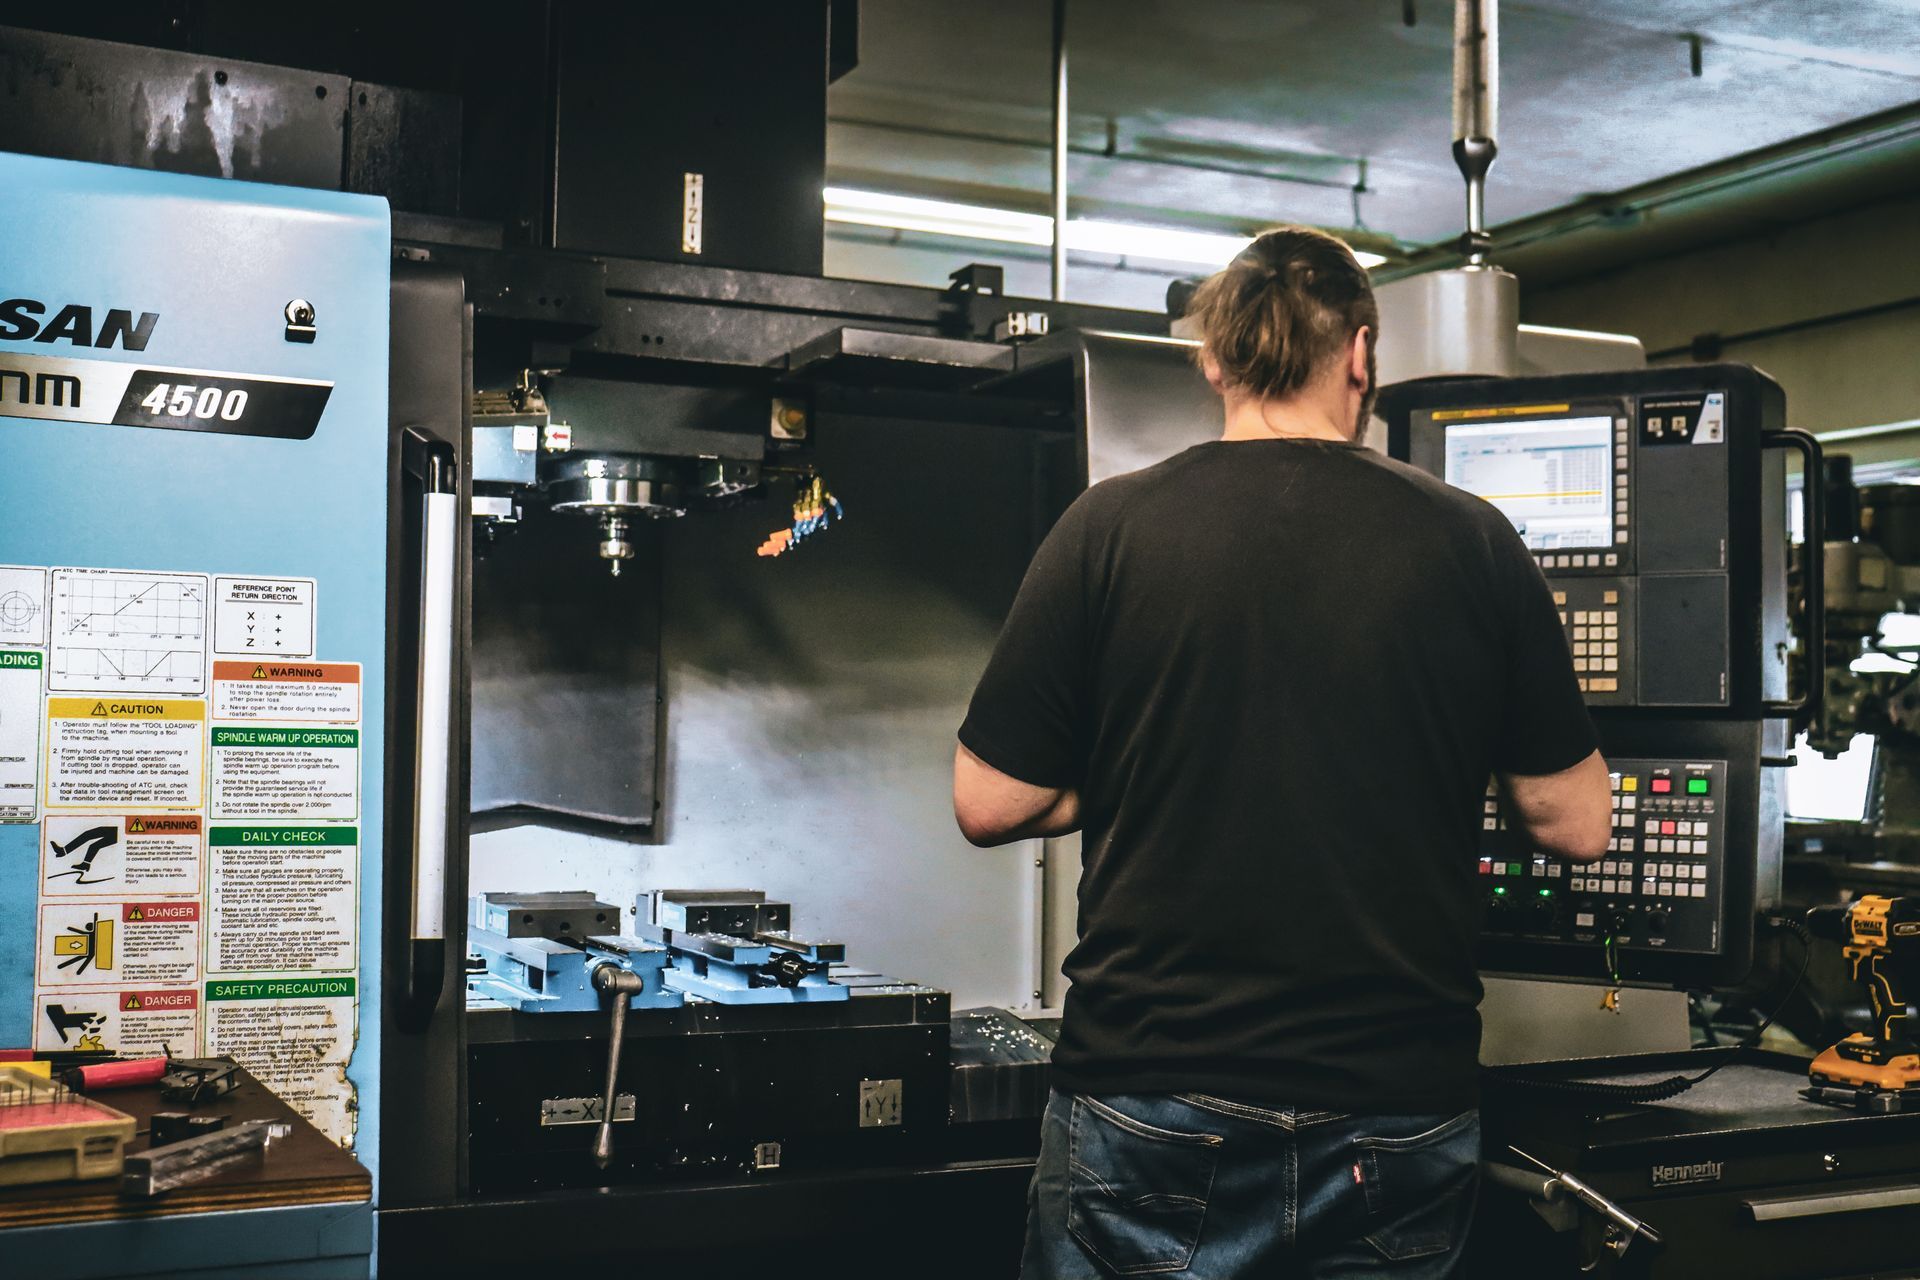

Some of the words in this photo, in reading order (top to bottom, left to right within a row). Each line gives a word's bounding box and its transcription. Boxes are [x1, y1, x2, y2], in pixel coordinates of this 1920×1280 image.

[0, 299, 160, 352] SAN
[141, 383, 248, 421] 4500
[270, 668, 323, 678] WARNING
[111, 705, 163, 714] CAUTION
[218, 733, 255, 742] SPINDLE
[258, 733, 286, 743] WARM
[288, 734, 300, 743] UP
[303, 734, 354, 744] OPERATION
[145, 820, 197, 829] WARNING
[243, 832, 279, 841] DAILY
[282, 832, 326, 841] CHECK
[148, 907, 194, 917] DANGER
[216, 985, 263, 995] SAFETY
[268, 983, 347, 994] PRECAUTION
[145, 996, 192, 1006] DANGER
[876, 1097, 887, 1113] Y
[582, 1103, 595, 1120] X
[1652, 1160, 1721, 1182] Kennedy
